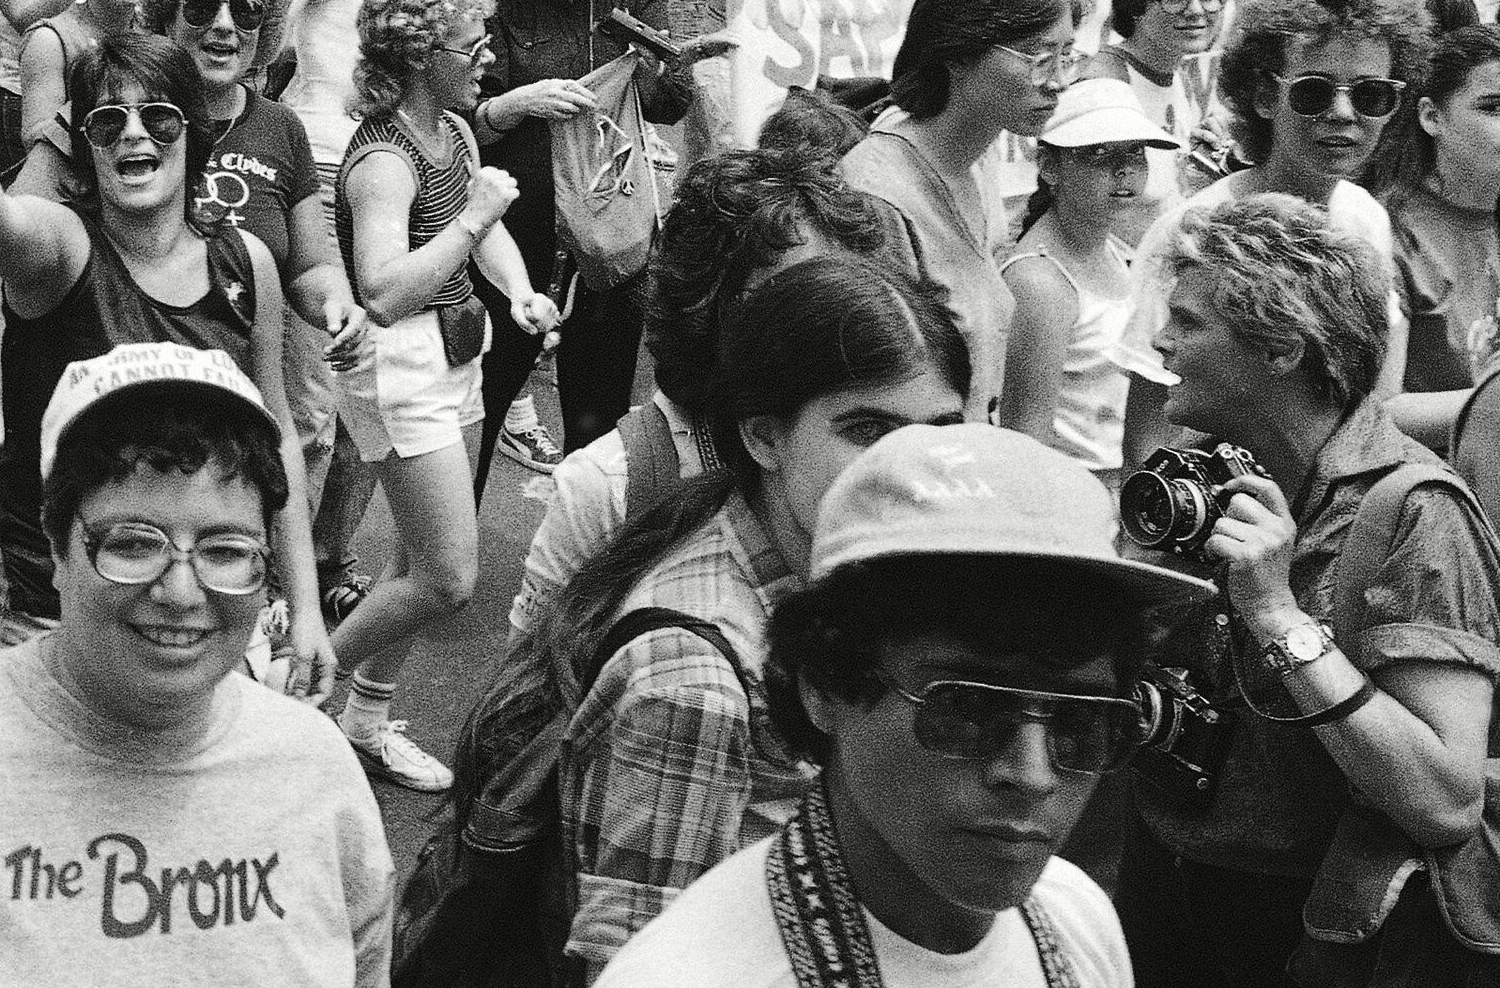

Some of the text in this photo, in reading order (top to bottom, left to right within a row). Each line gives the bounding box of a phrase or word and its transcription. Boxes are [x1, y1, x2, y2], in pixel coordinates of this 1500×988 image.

[93, 362, 193, 396] CANNOT
[4, 832, 287, 940] The Bronx
